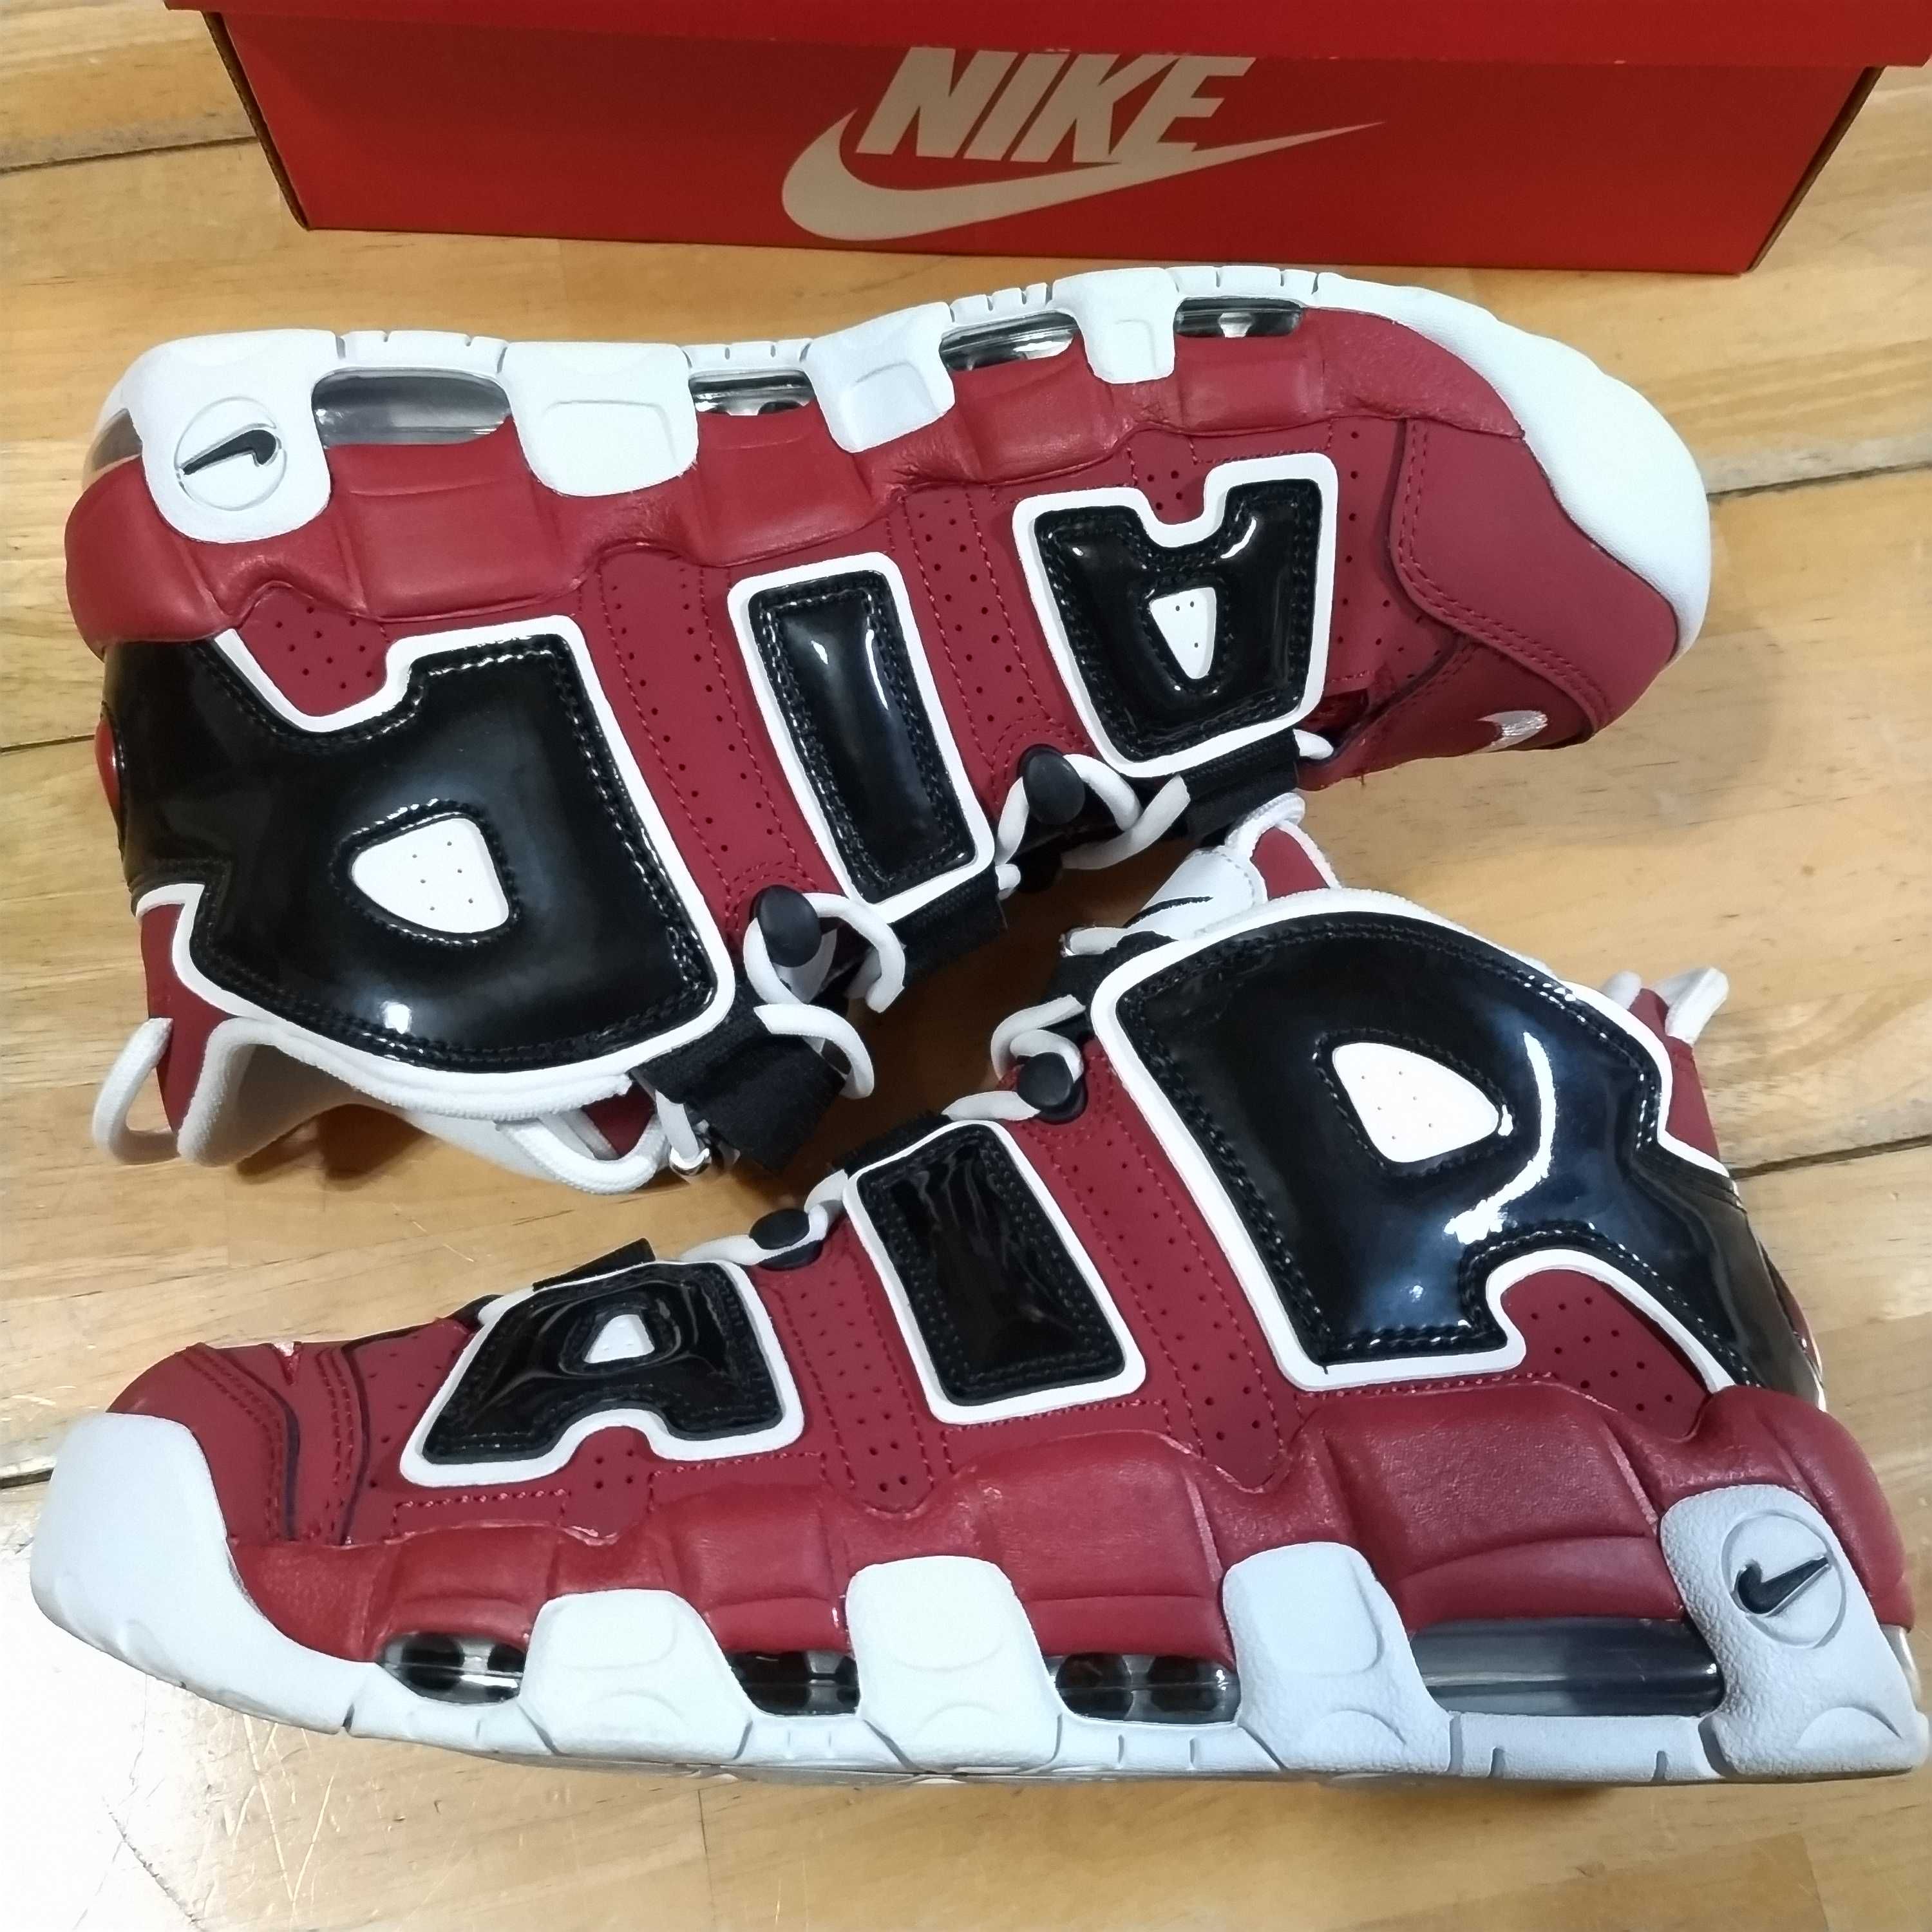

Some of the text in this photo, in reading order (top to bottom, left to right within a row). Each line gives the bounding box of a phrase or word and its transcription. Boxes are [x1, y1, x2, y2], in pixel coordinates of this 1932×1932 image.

[855, 47, 1256, 162] NIKE
[105, 452, 1338, 1075] AIR
[400, 894, 1823, 1485] AIR
